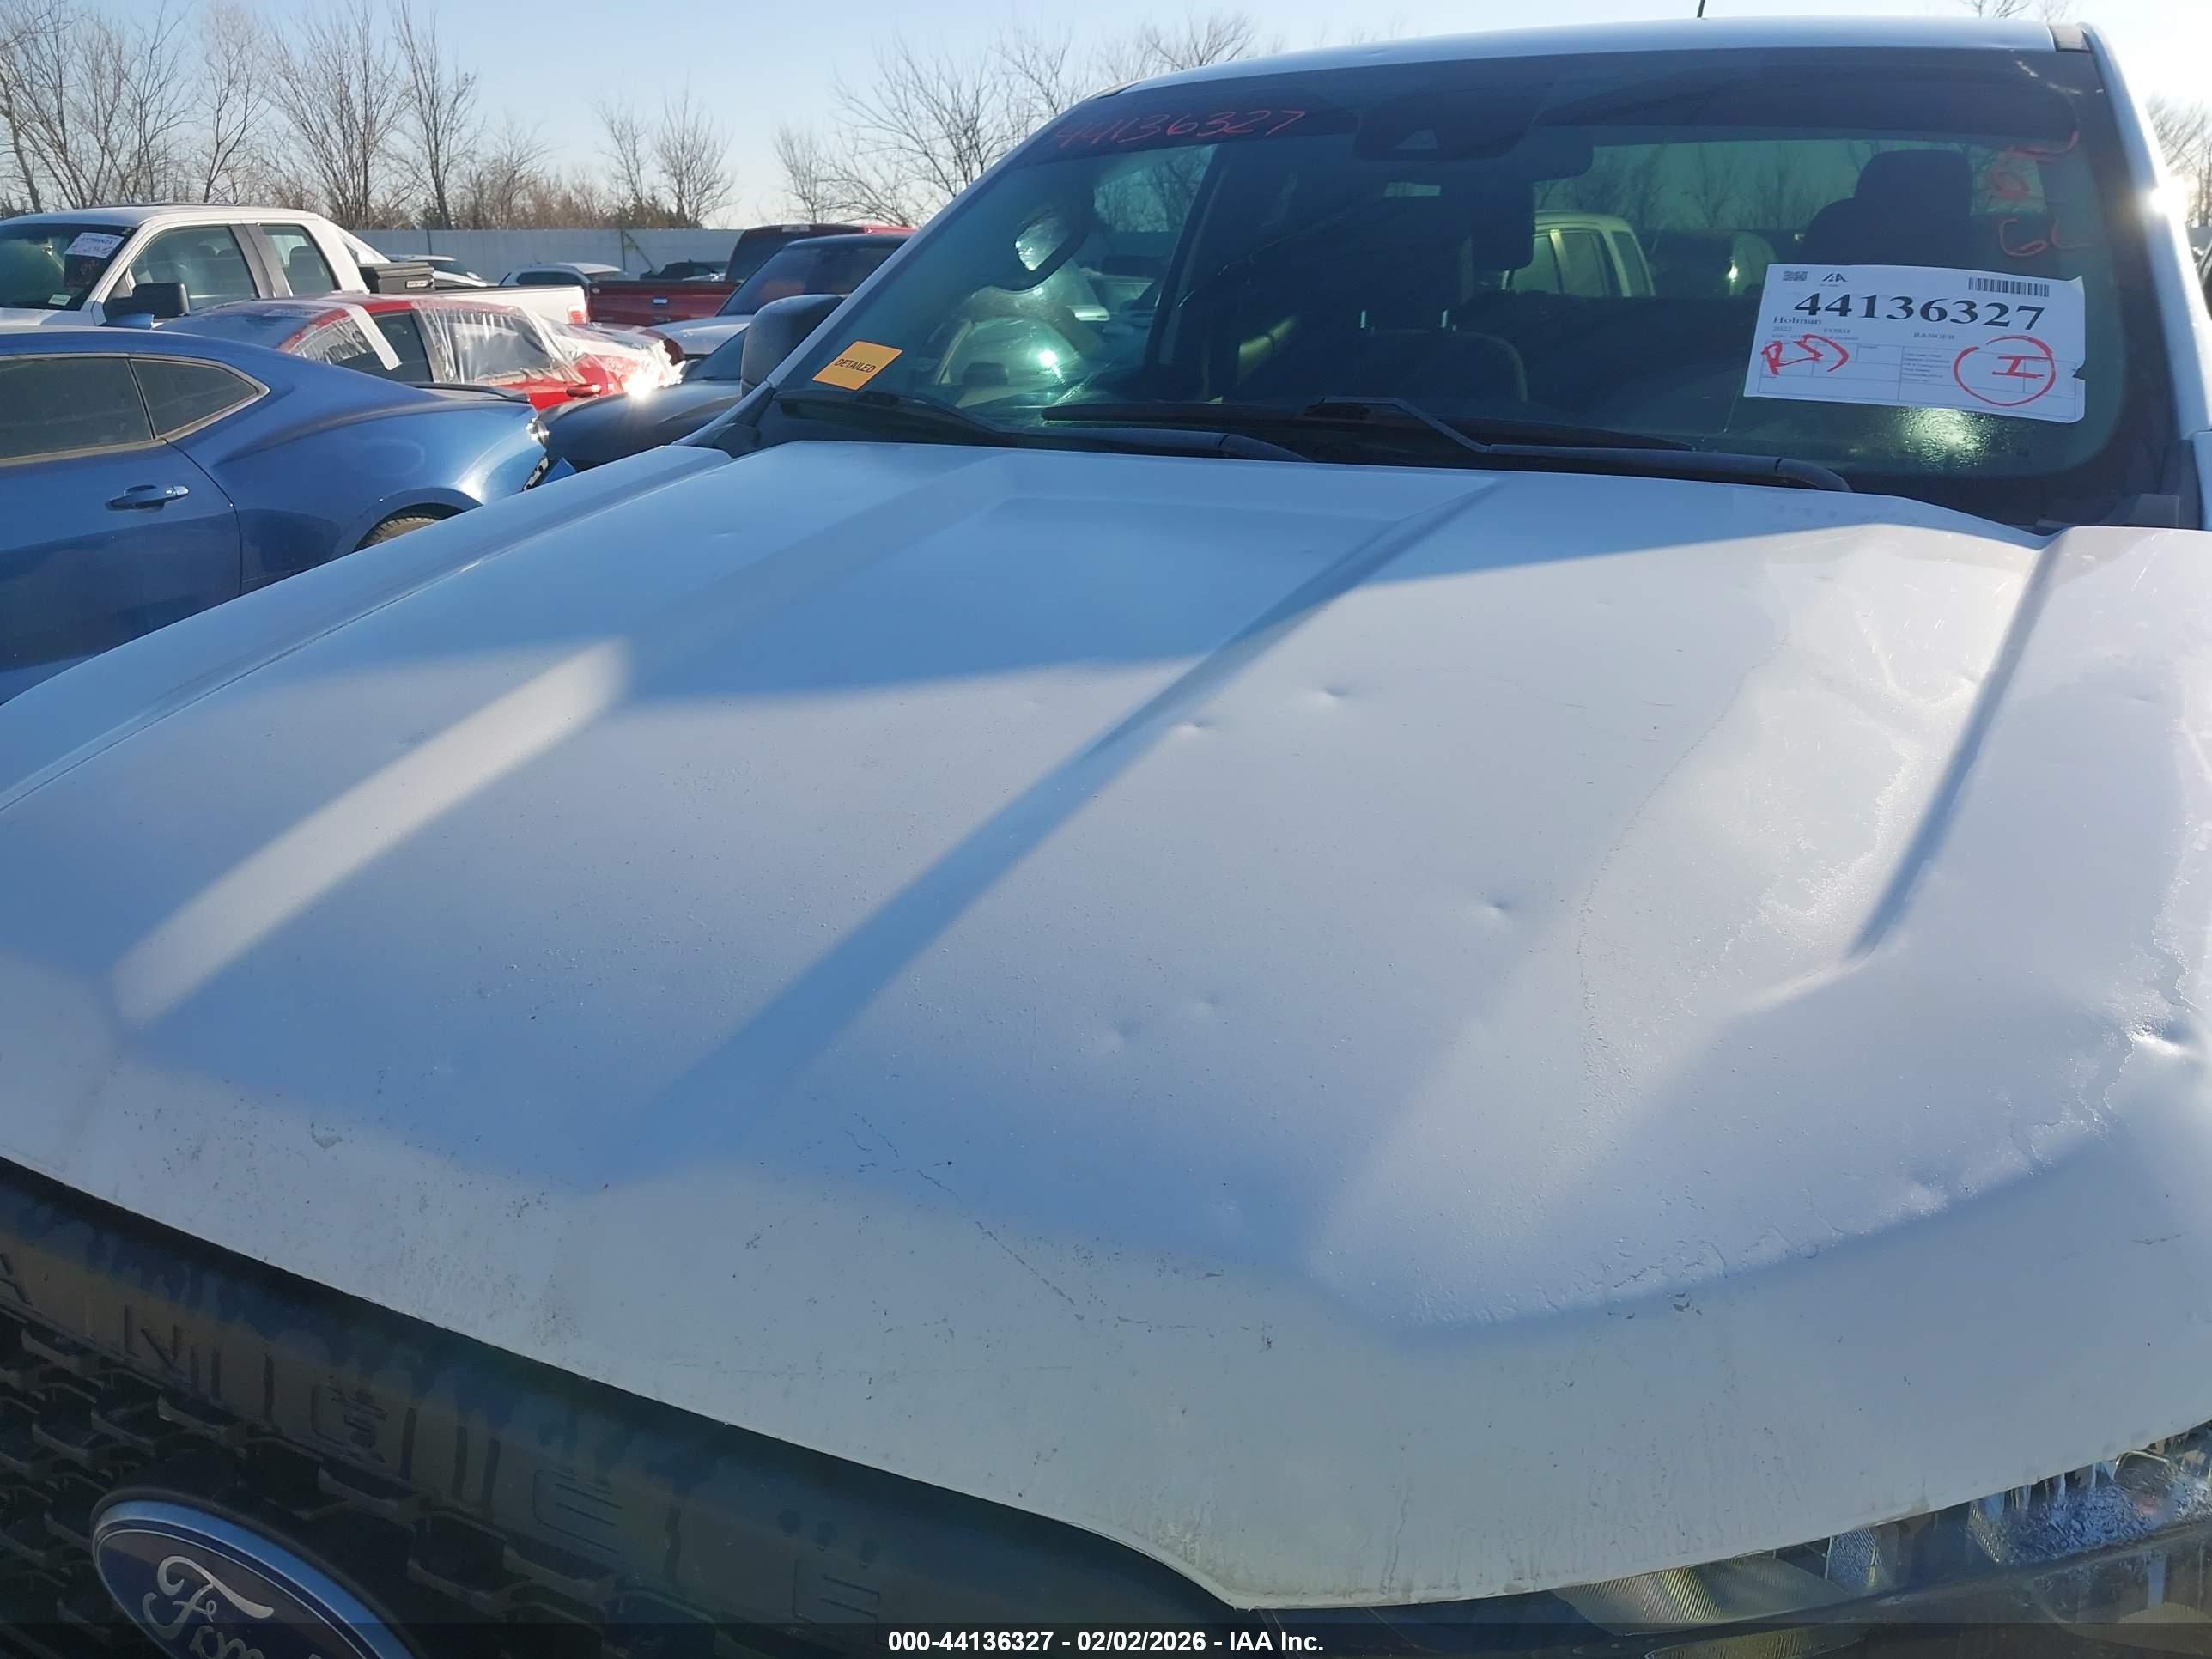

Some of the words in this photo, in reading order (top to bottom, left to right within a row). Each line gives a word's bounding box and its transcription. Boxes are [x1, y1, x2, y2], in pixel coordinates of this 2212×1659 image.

[1054, 110, 1305, 148] 44136327
[1773, 316, 1822, 325] Holman
[1794, 292, 2045, 330] 44136327
[834, 358, 877, 374] DETAILED
